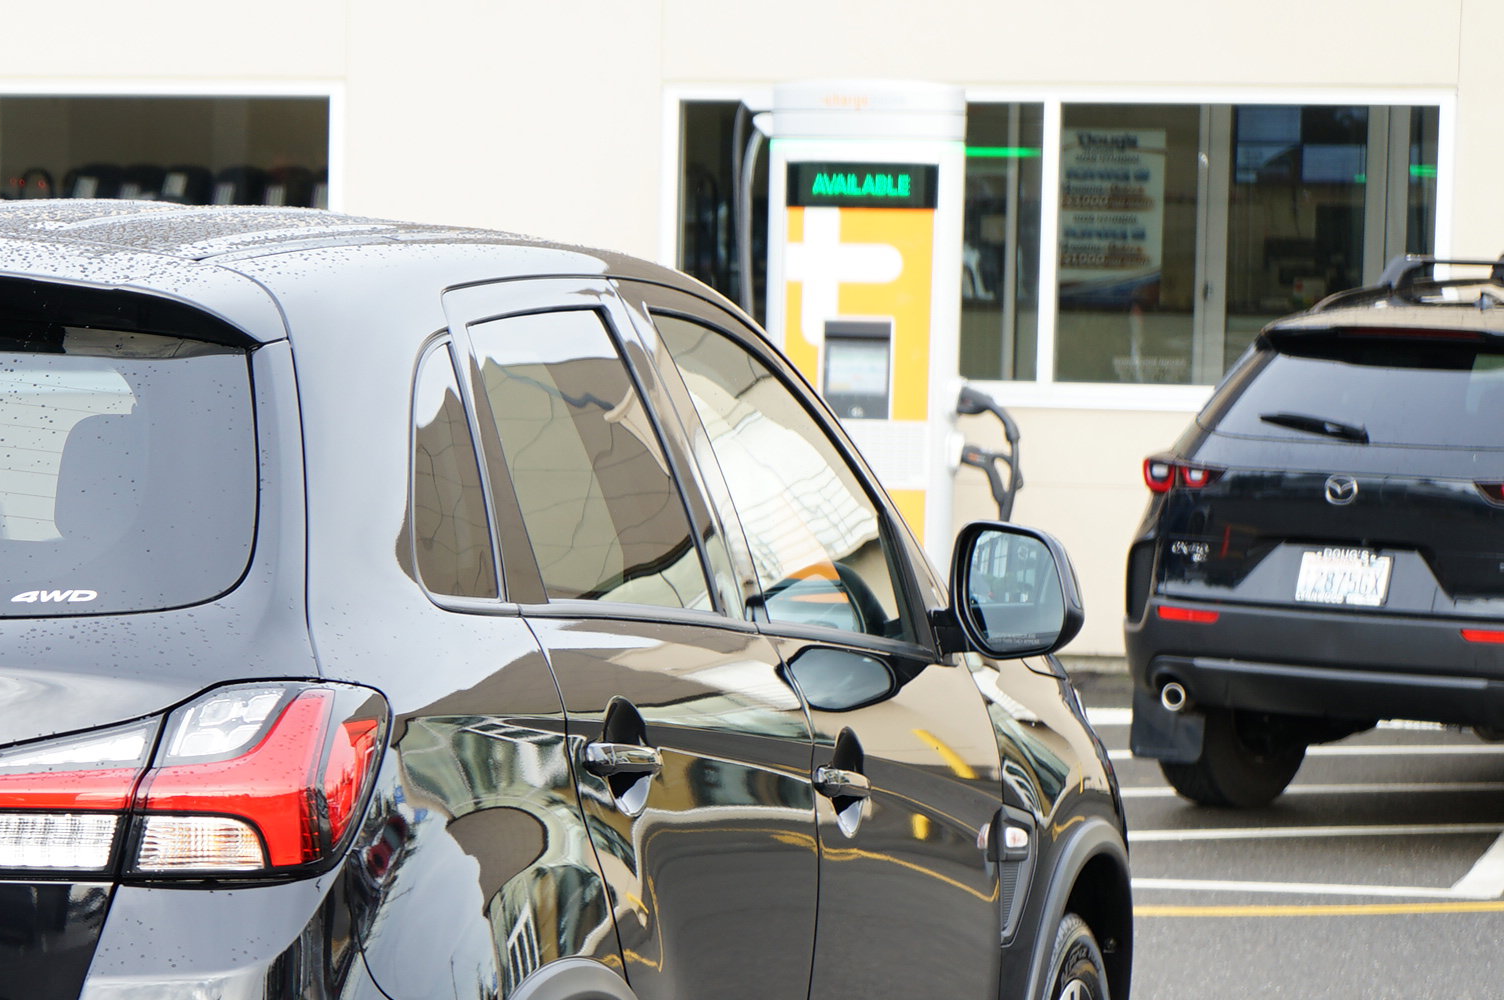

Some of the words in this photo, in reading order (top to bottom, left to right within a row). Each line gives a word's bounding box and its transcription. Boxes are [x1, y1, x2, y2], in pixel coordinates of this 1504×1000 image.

[811, 173, 911, 197] AVAILABLE
[1323, 547, 1370, 562] DOUG'S
[10, 589, 98, 603] 4WD
